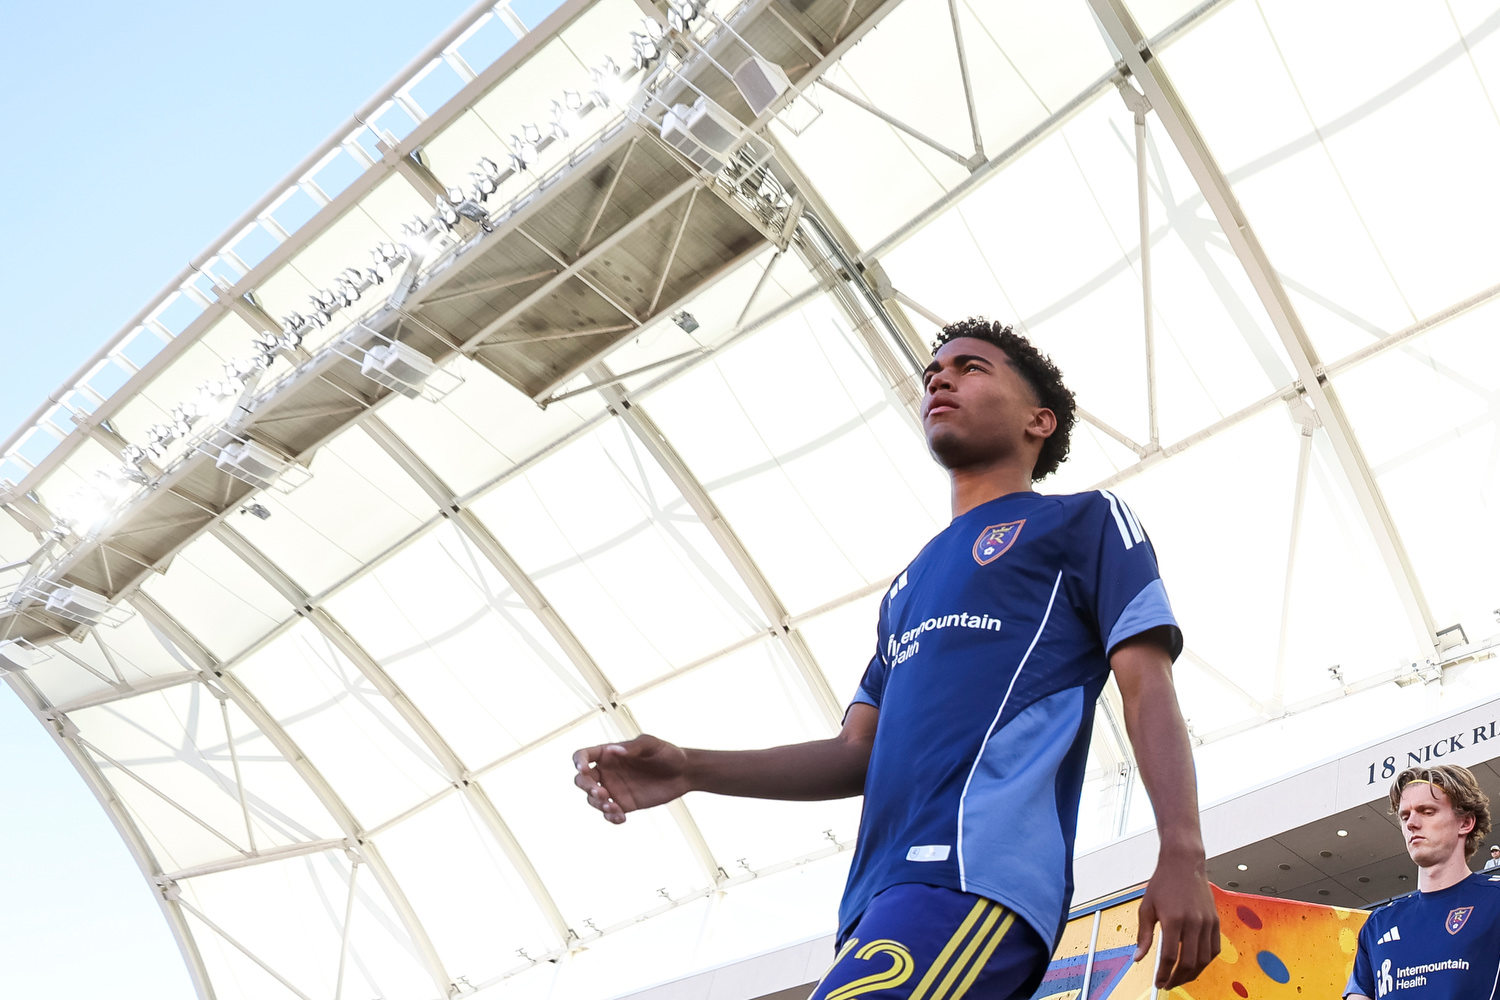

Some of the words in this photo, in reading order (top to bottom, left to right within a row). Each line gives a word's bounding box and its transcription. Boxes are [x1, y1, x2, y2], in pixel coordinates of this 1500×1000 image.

[1366, 756, 1396, 786] 18
[1406, 733, 1465, 768] NICK
[1396, 958, 1470, 979] Intermountain
[1396, 975, 1427, 990] Health
